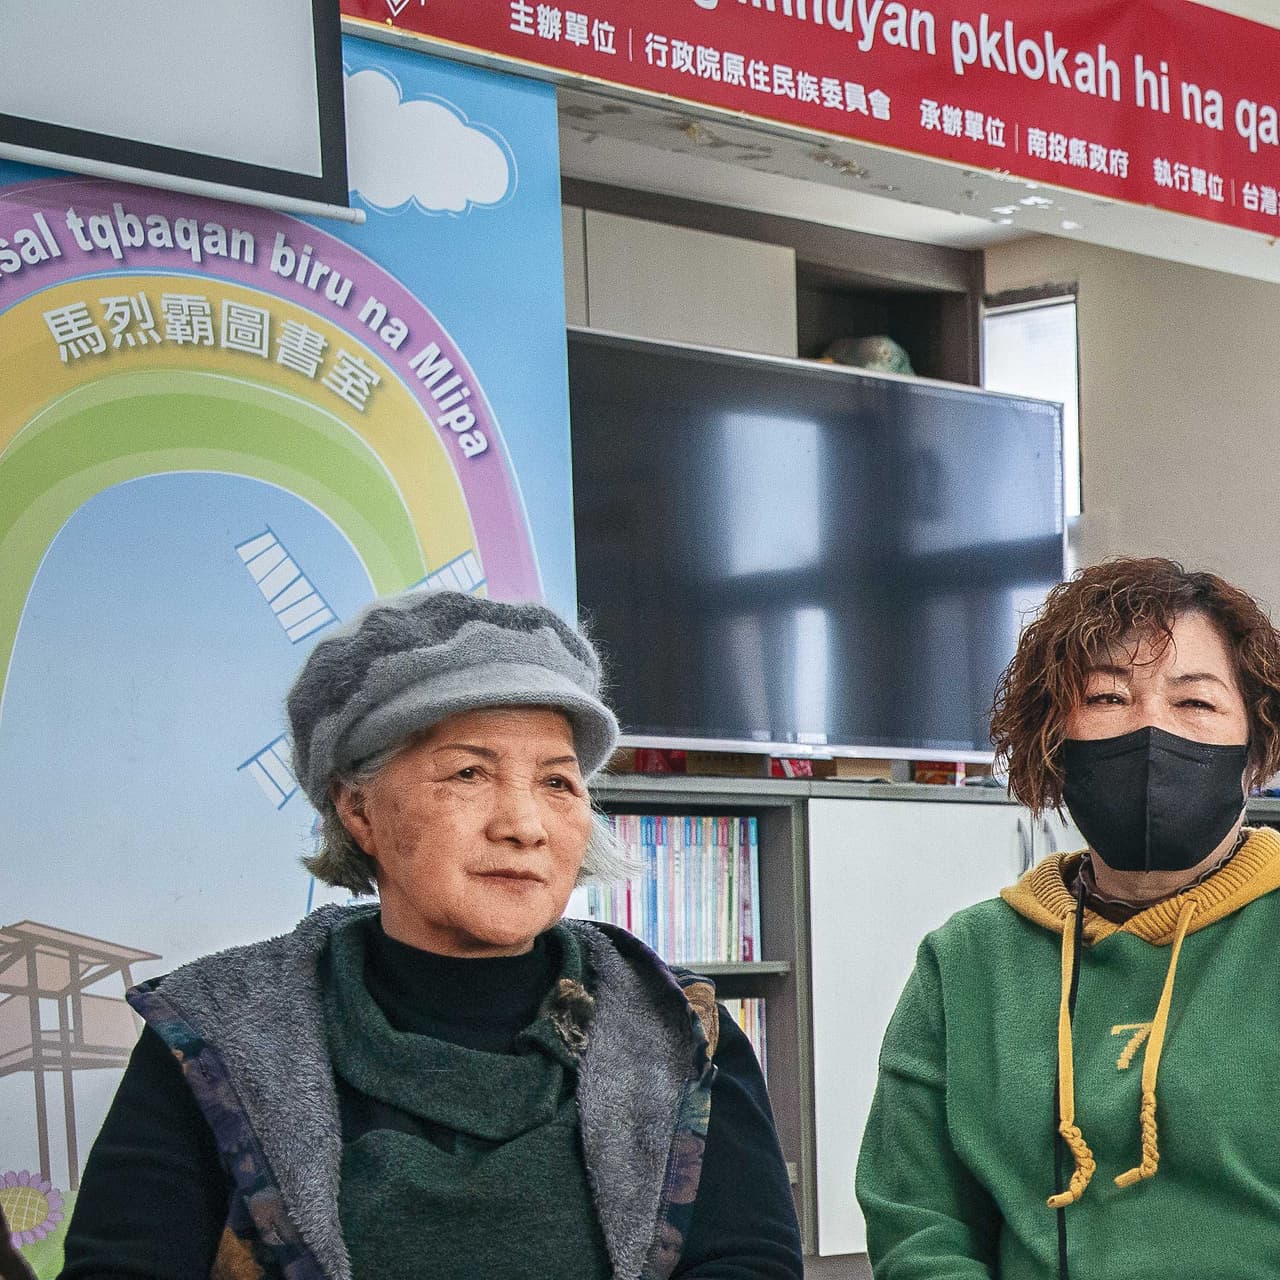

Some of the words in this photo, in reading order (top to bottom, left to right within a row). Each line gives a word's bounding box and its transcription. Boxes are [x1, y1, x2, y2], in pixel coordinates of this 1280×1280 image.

[509, 0, 617, 55] 主辦單位
[644, 31, 891, 121] 行政院原住民族委員會
[919, 98, 1006, 149] 承辦單位
[1027, 126, 1129, 179] 南投縣政府
[1152, 156, 1225, 203] 執行單位
[951, 12, 1122, 102] pklokah
[1134, 53, 1170, 114] hi
[1181, 80, 1225, 131] na
[0, 211, 62, 278] sal
[65, 202, 256, 265] tqbaqan
[269, 231, 354, 308] biru
[357, 295, 409, 351] na
[408, 341, 489, 458] Mlipa
[42, 290, 381, 412] 馬烈霸圖書室
